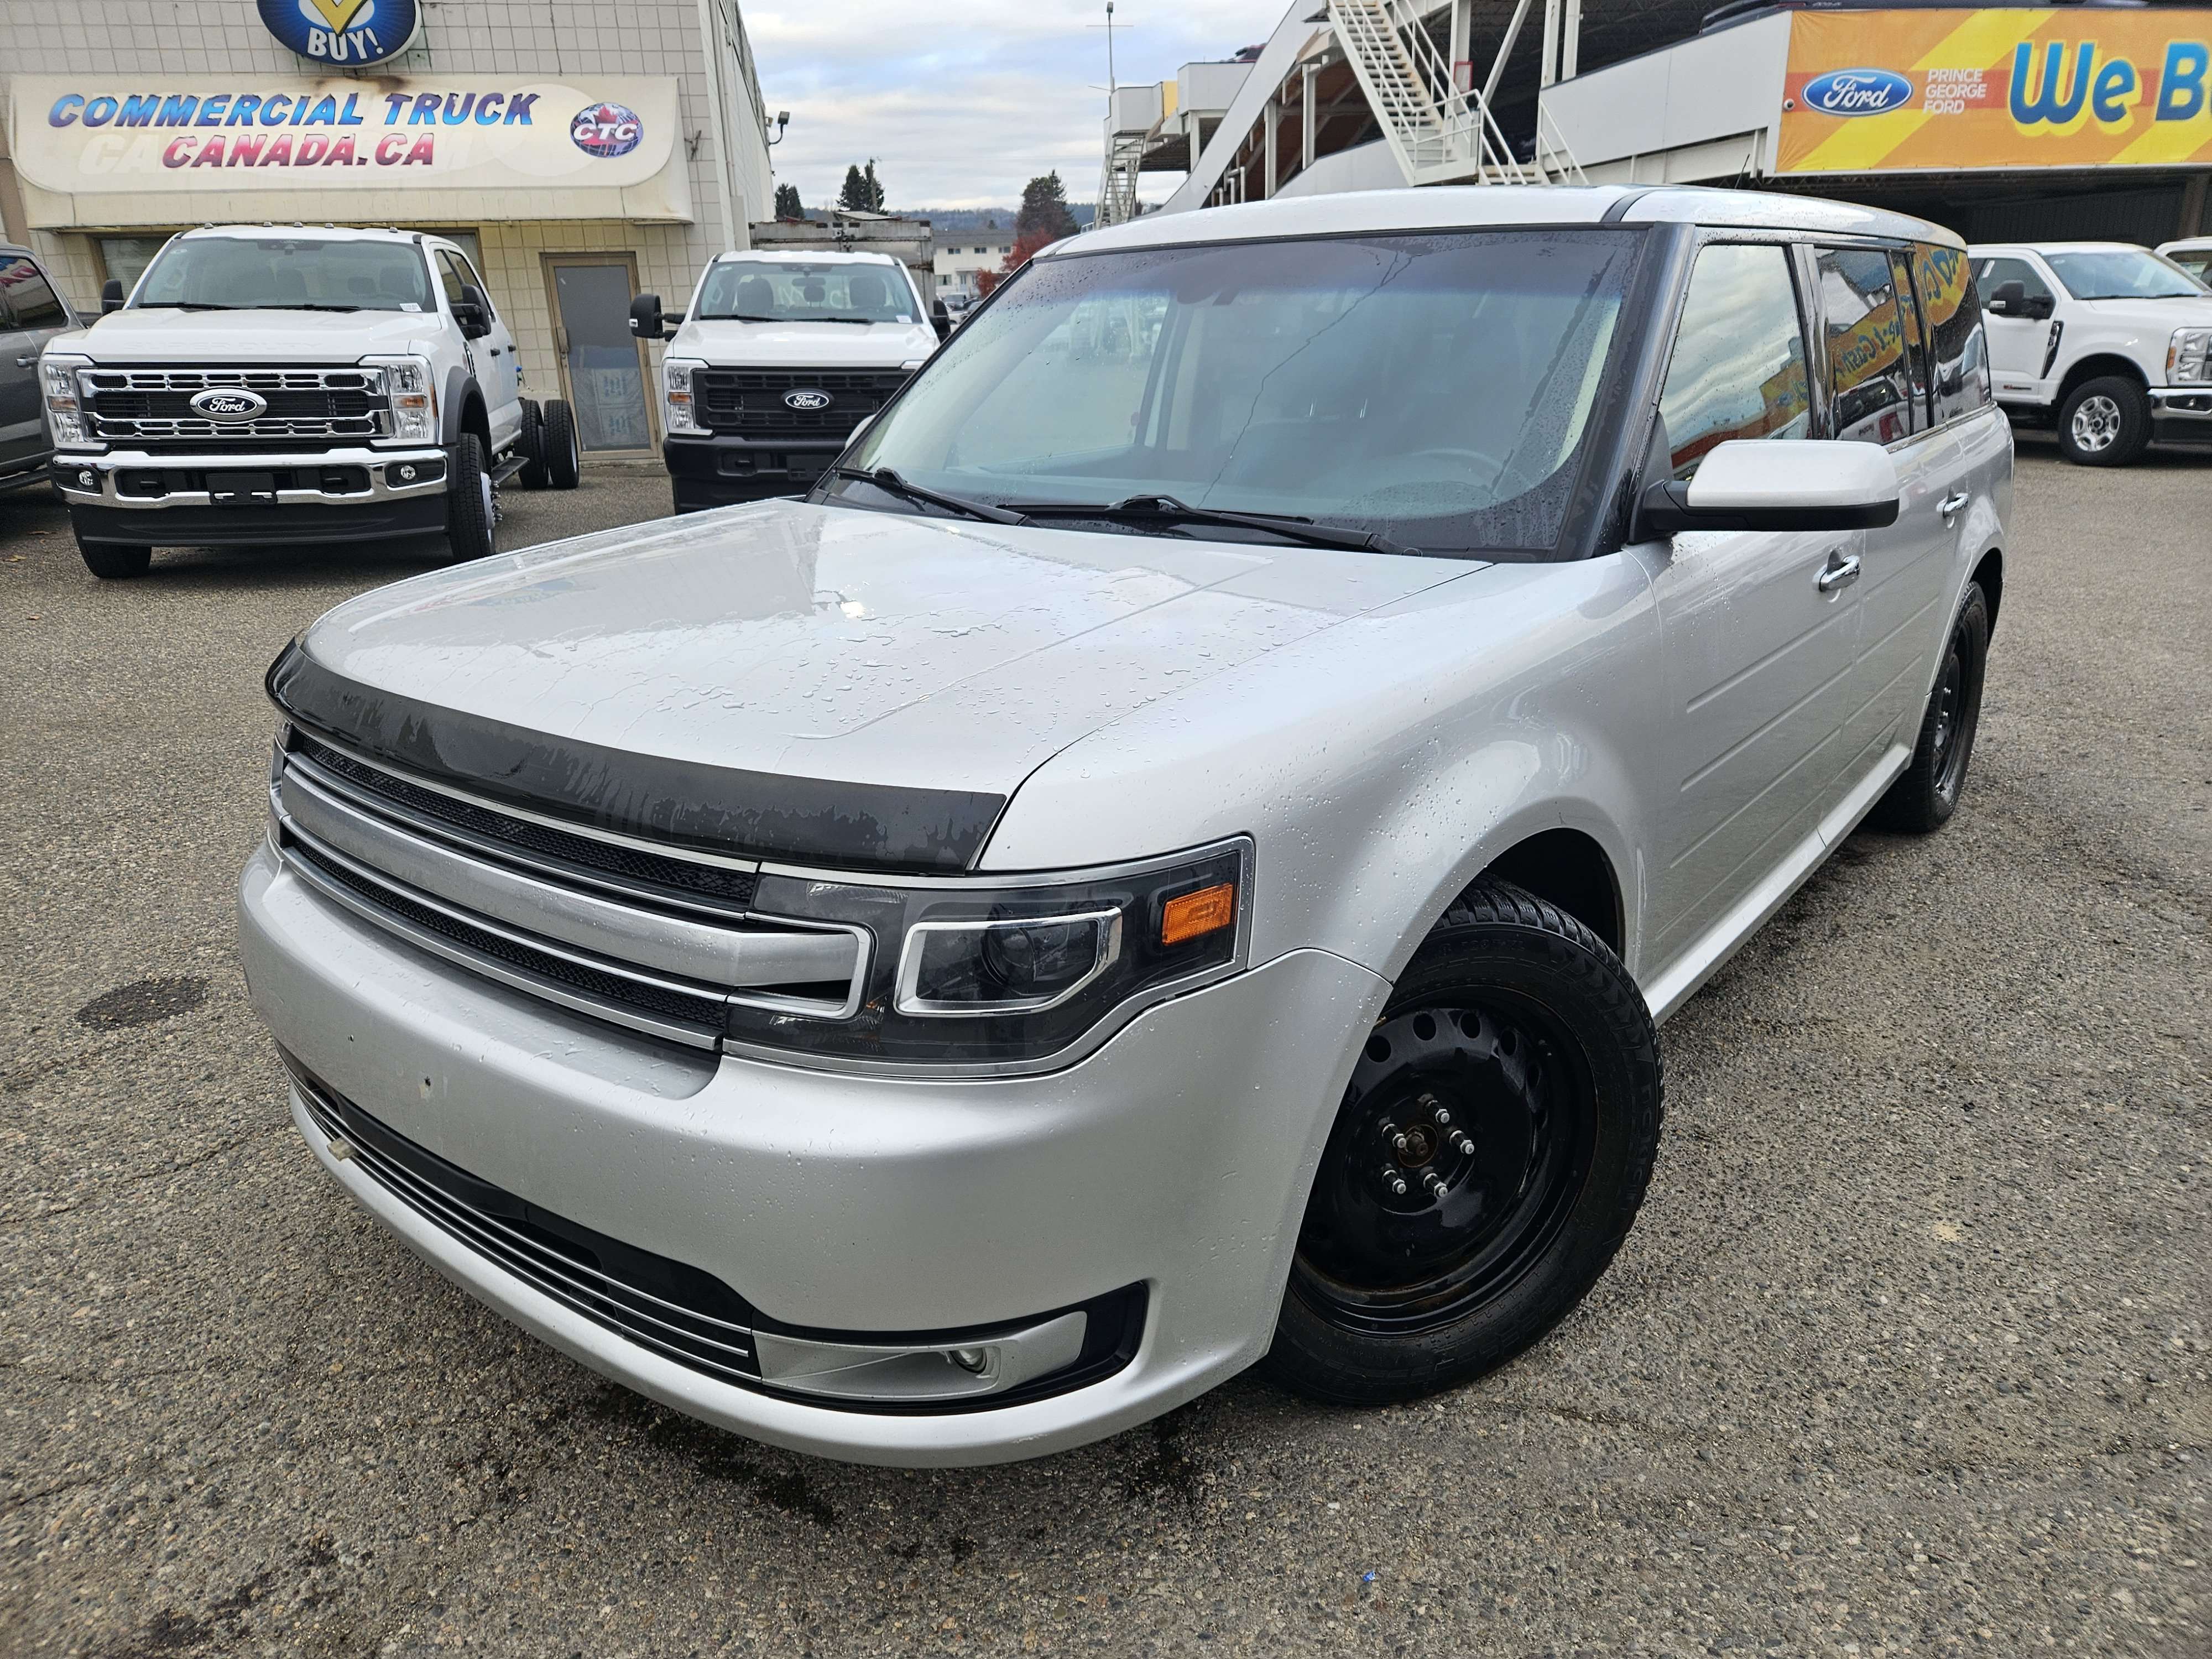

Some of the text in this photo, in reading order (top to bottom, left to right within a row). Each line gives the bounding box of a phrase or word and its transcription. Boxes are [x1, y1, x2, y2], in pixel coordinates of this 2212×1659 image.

[307, 27, 384, 61] BUY!
[1928, 69, 1984, 83] PRINCE
[2010, 41, 2212, 124] We B
[1823, 75, 1892, 108] Ford
[1925, 84, 1987, 98] GEORGE
[48, 92, 541, 128] COMMERCIAL TRUCK
[1923, 99, 1965, 115] FORD
[573, 123, 637, 141] CTC
[162, 133, 434, 169] CANADA.CA
[209, 397, 246, 411] Ford
[794, 394, 821, 406] Ford
